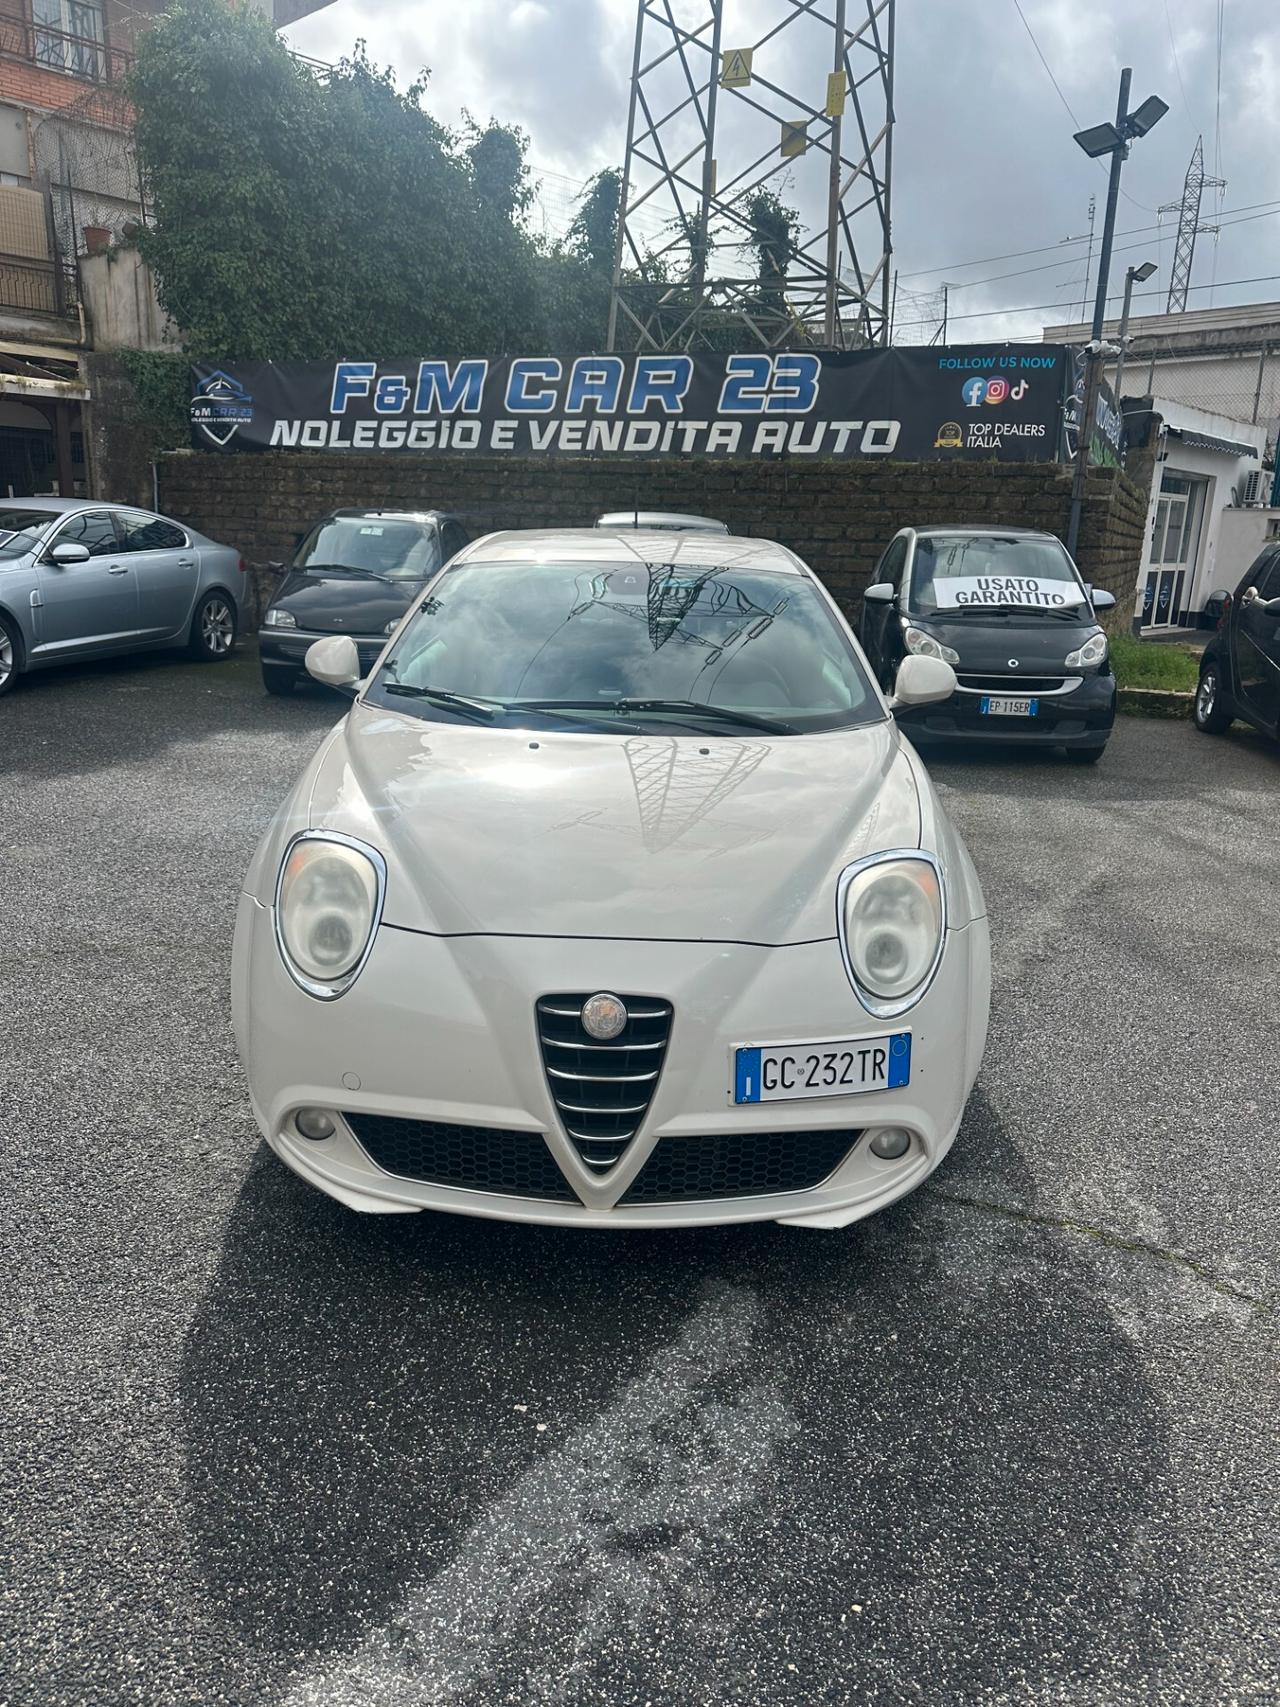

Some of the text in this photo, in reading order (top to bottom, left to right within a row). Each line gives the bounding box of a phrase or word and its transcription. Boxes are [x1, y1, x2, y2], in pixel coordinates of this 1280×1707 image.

[939, 357, 1056, 369] FOLLOW US NOW
[330, 353, 822, 414] F&M CAR 23
[269, 419, 902, 454] NOLEGGIO E VENDITA AUTO
[968, 423, 1046, 437] TOP DEALERS
[966, 436, 1003, 448] ITALIA
[977, 578, 1039, 592] USATO
[955, 590, 1065, 605] GARANTITO
